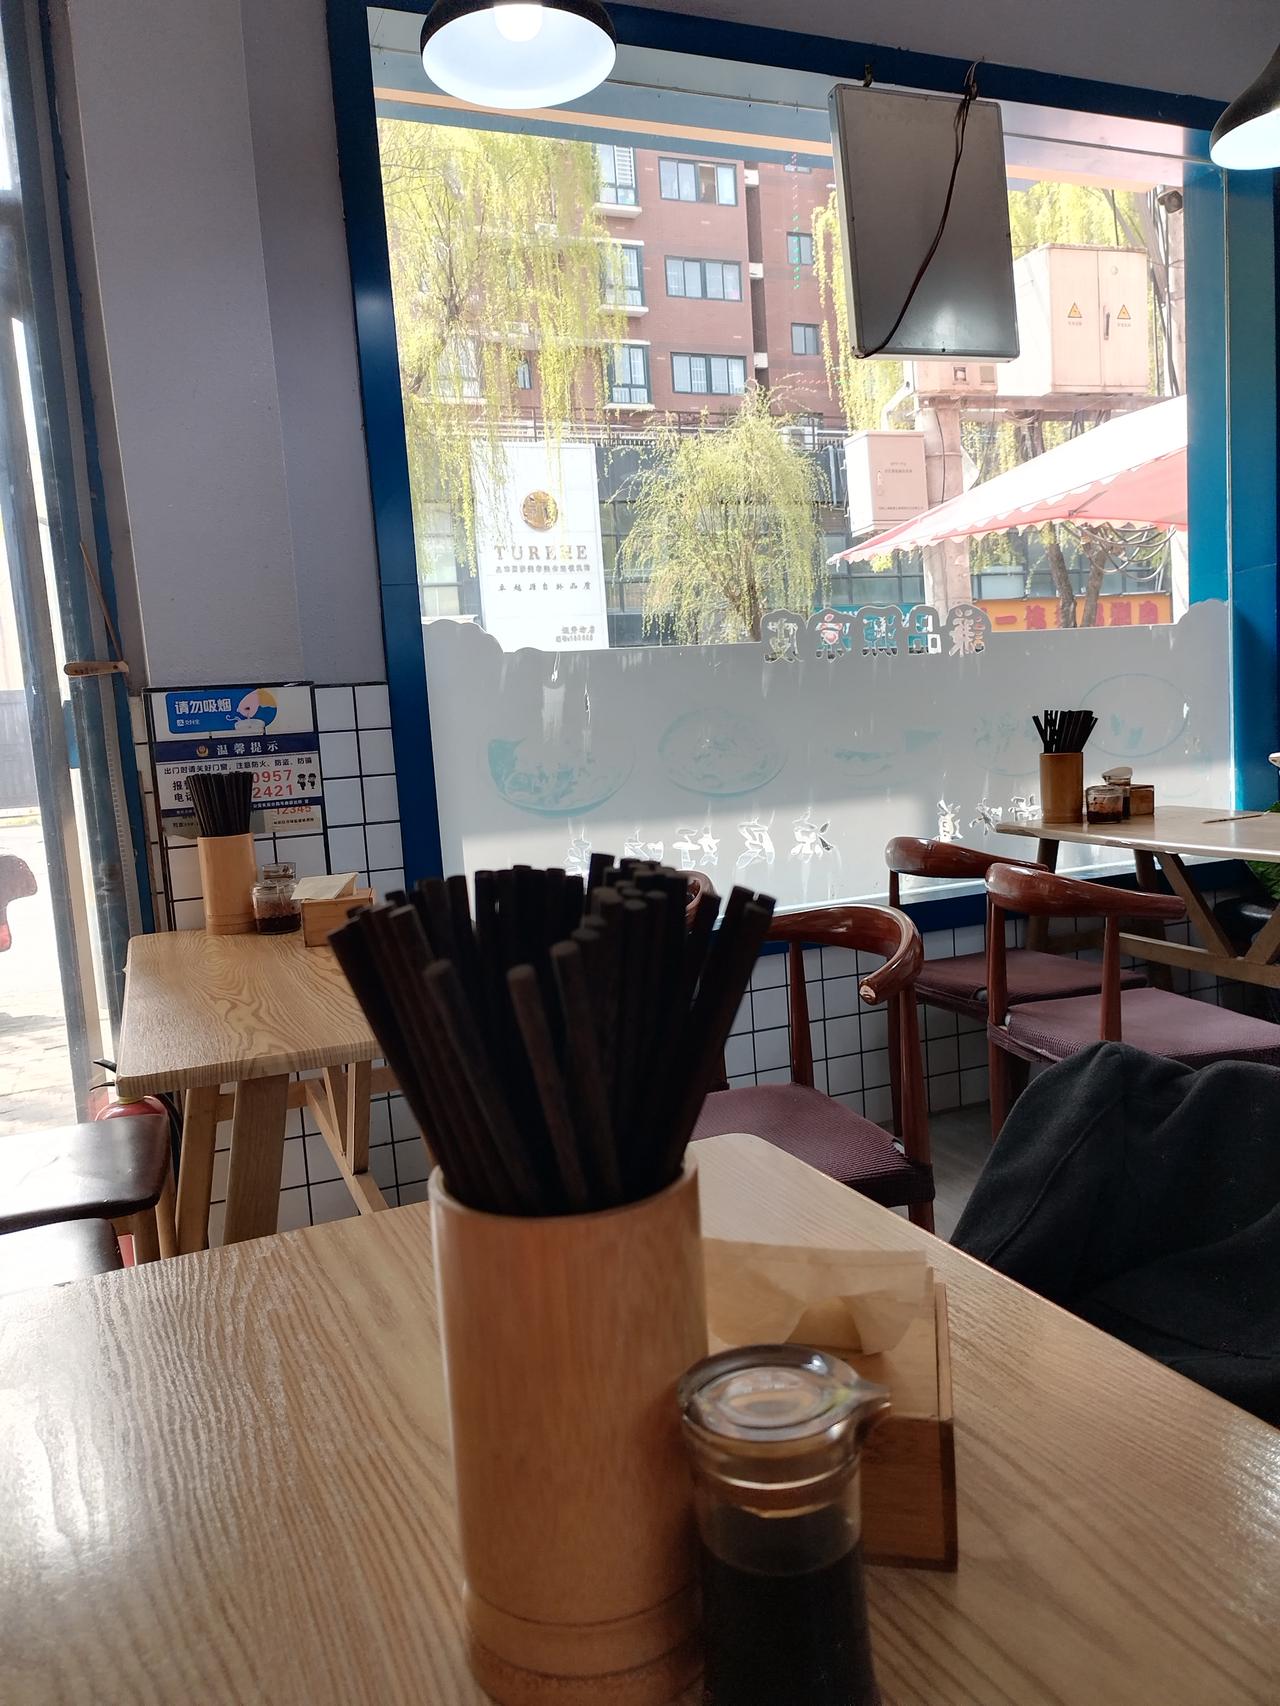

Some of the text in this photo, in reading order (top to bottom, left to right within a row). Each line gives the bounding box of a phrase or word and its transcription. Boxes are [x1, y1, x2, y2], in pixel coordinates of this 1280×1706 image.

[175, 698, 232, 715] 请勿吸烟
[216, 740, 279, 756] 温馨提示
[253, 784, 293, 798] 2421
